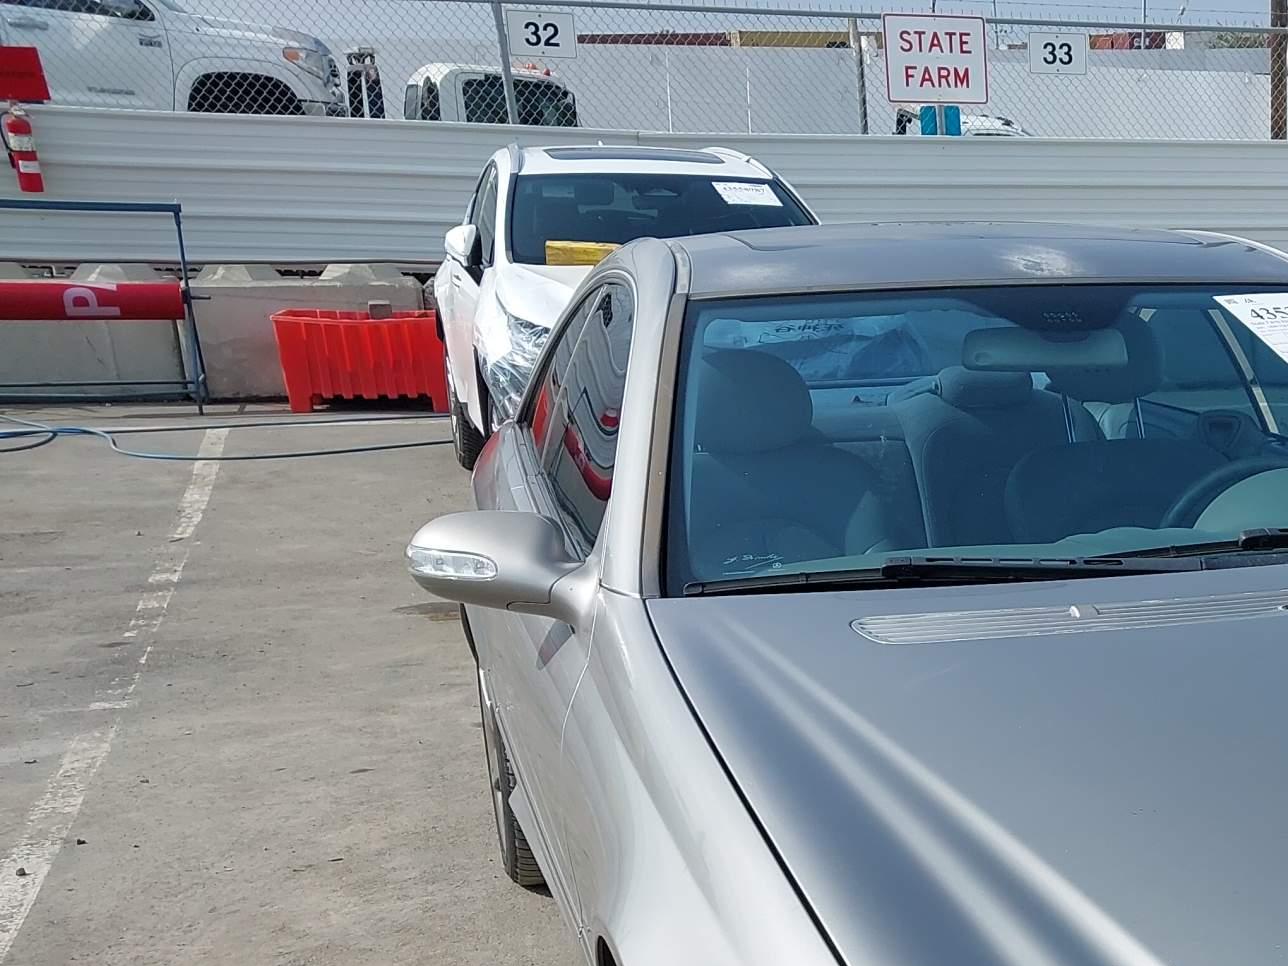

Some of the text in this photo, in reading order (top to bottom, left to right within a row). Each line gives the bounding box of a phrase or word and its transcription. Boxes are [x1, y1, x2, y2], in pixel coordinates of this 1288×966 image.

[524, 21, 561, 47] 32
[899, 30, 972, 54] STATE
[1042, 42, 1073, 66] 33
[904, 65, 971, 89] FARM
